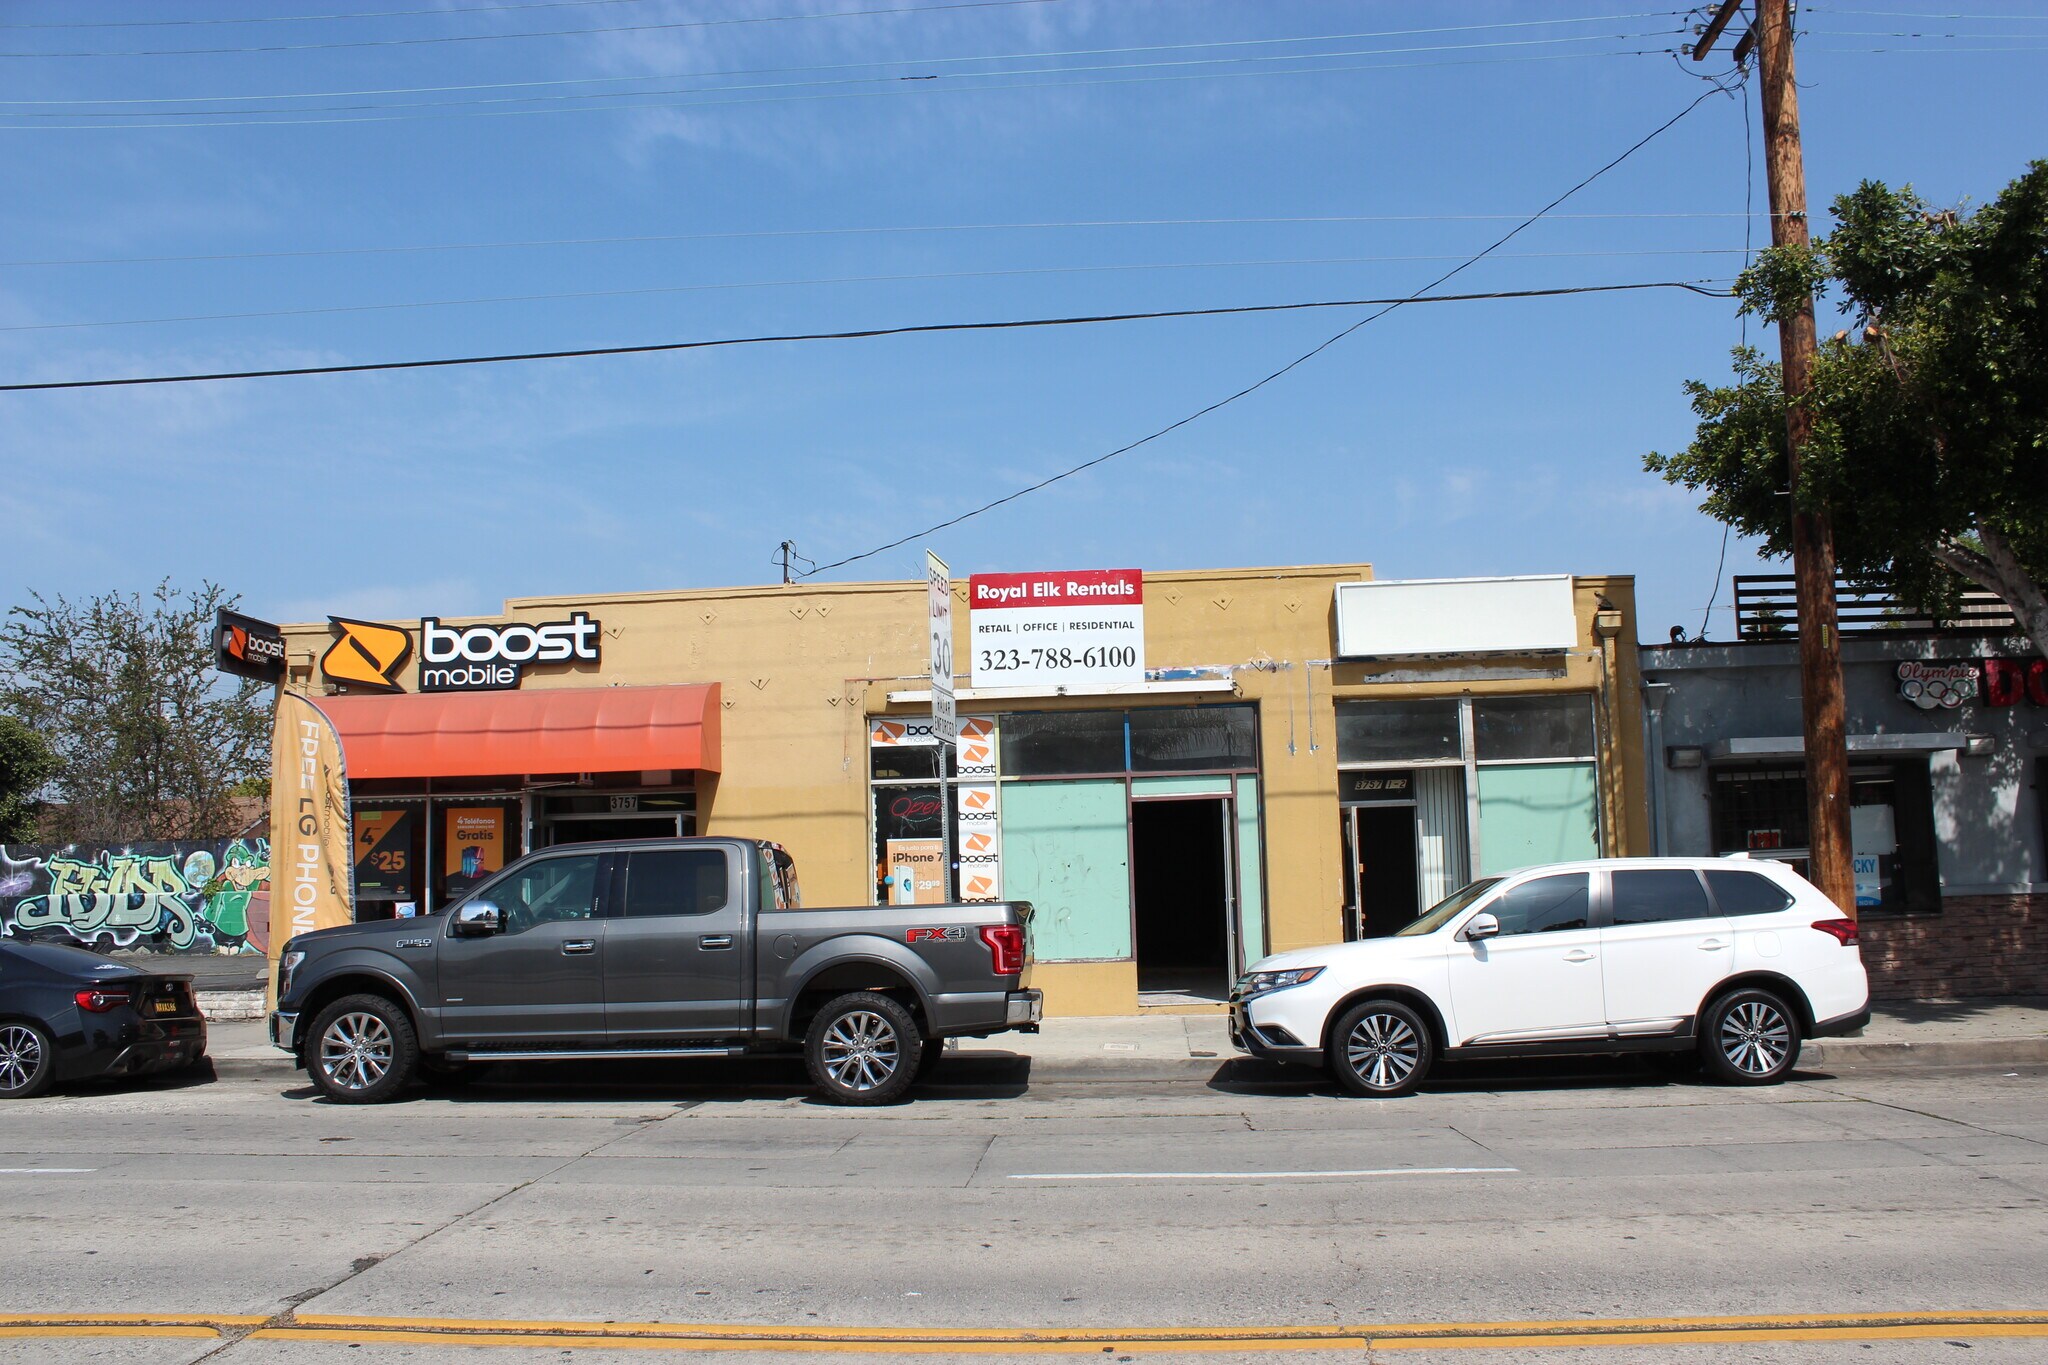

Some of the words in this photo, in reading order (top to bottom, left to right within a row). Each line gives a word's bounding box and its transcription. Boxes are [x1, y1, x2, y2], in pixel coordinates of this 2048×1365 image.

[929, 566, 949, 597] SPEED
[977, 582, 1027, 602] Royal
[1033, 582, 1061, 597] Elk
[1066, 579, 1135, 596] Rentals
[932, 599, 948, 623] LIMIT
[978, 624, 1012, 633] RETAIL
[1023, 622, 1058, 631] OFFICE
[1069, 621, 1135, 630] RESIDENTIAL
[248, 633, 284, 658] boost
[424, 615, 597, 663] boost
[248, 653, 268, 663] mobile
[933, 632, 951, 680] 30
[979, 646, 1136, 671] 323-788-6100
[424, 664, 515, 686] mobile
[1900, 662, 1977, 682] Olympic
[300, 720, 320, 791] FREE
[957, 764, 996, 774] boost
[1356, 780, 1382, 789] 3757
[611, 796, 637, 809] 3757
[299, 798, 317, 837] LG
[958, 811, 998, 821] boost
[360, 827, 374, 845] 4
[457, 829, 494, 840] Gratis
[370, 850, 406, 870] $25
[893, 853, 934, 863] iPhone
[960, 853, 999, 862] boost
[1854, 858, 1875, 873] CKY
[906, 926, 966, 943] FX4
